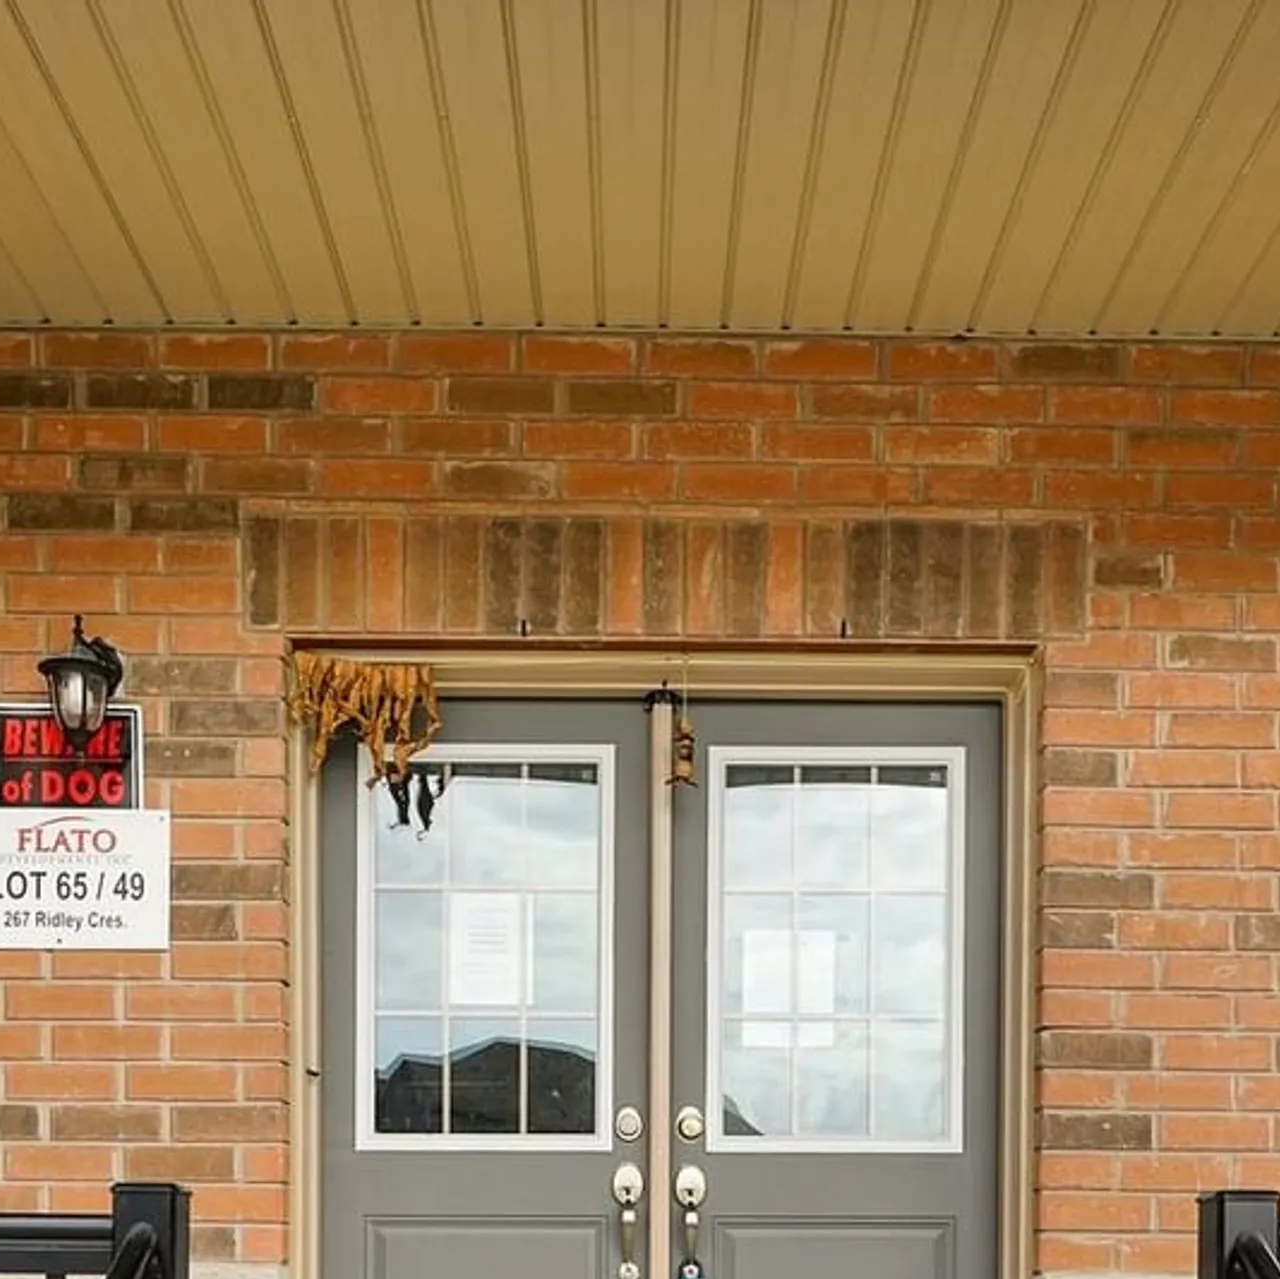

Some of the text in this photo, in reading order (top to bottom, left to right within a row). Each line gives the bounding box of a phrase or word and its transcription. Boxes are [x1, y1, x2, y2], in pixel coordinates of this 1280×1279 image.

[3, 718, 124, 757] BEWRE
[2, 769, 125, 804] of DOG
[17, 828, 117, 853] FLATO
[56, 871, 87, 901] 65
[95, 872, 106, 901] /
[113, 871, 145, 901] 49
[4, 911, 127, 932] 267 Ridley Cres.
